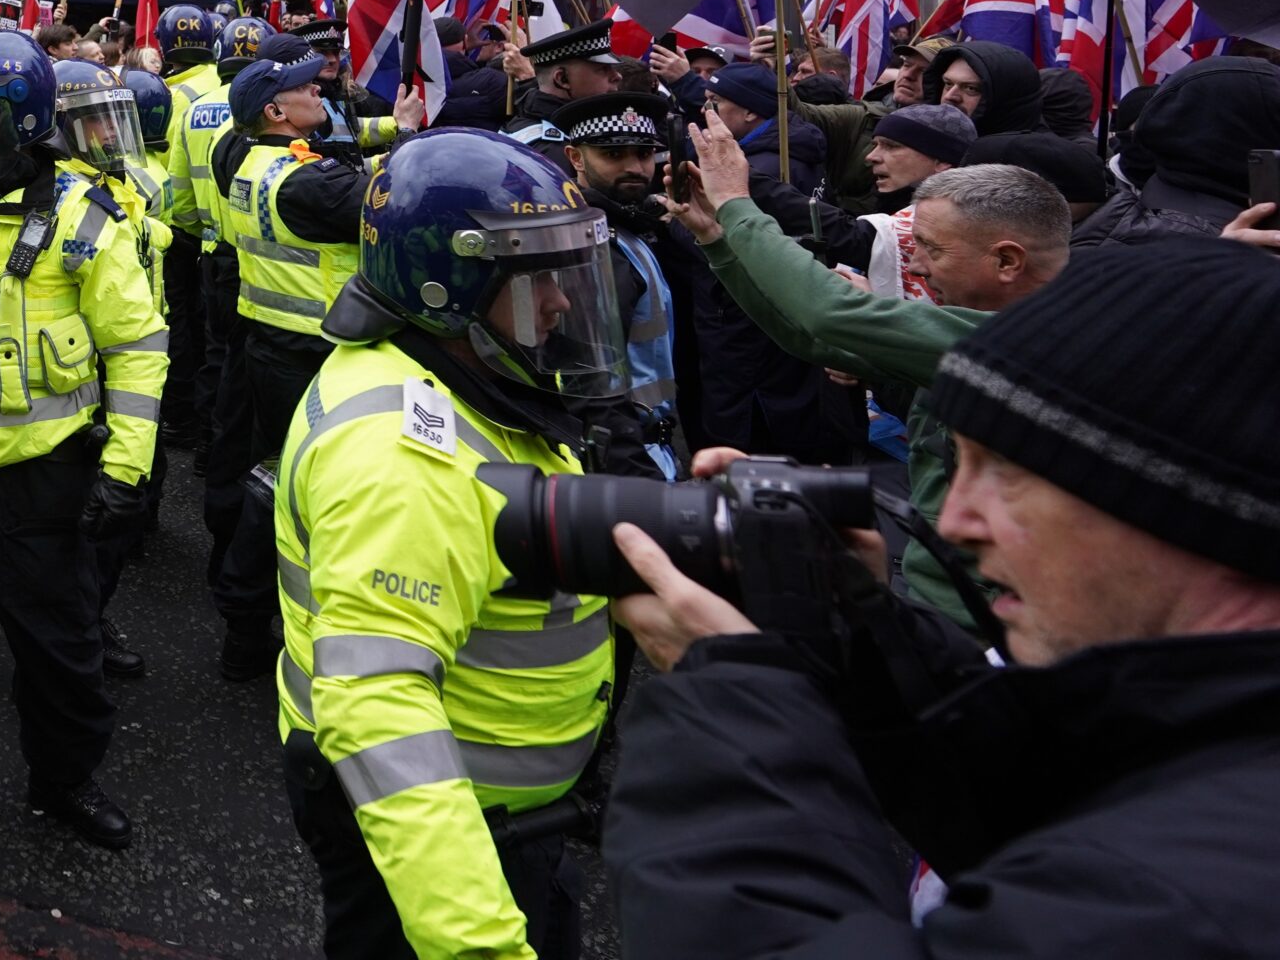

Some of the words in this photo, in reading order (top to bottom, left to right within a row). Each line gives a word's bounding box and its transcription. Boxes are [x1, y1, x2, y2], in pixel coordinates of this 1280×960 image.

[177, 18, 201, 31] CK
[234, 25, 261, 41] CK
[233, 42, 244, 57] X
[193, 108, 231, 127] POLIC
[412, 422, 443, 445] 16530
[371, 568, 443, 608] POLICE
